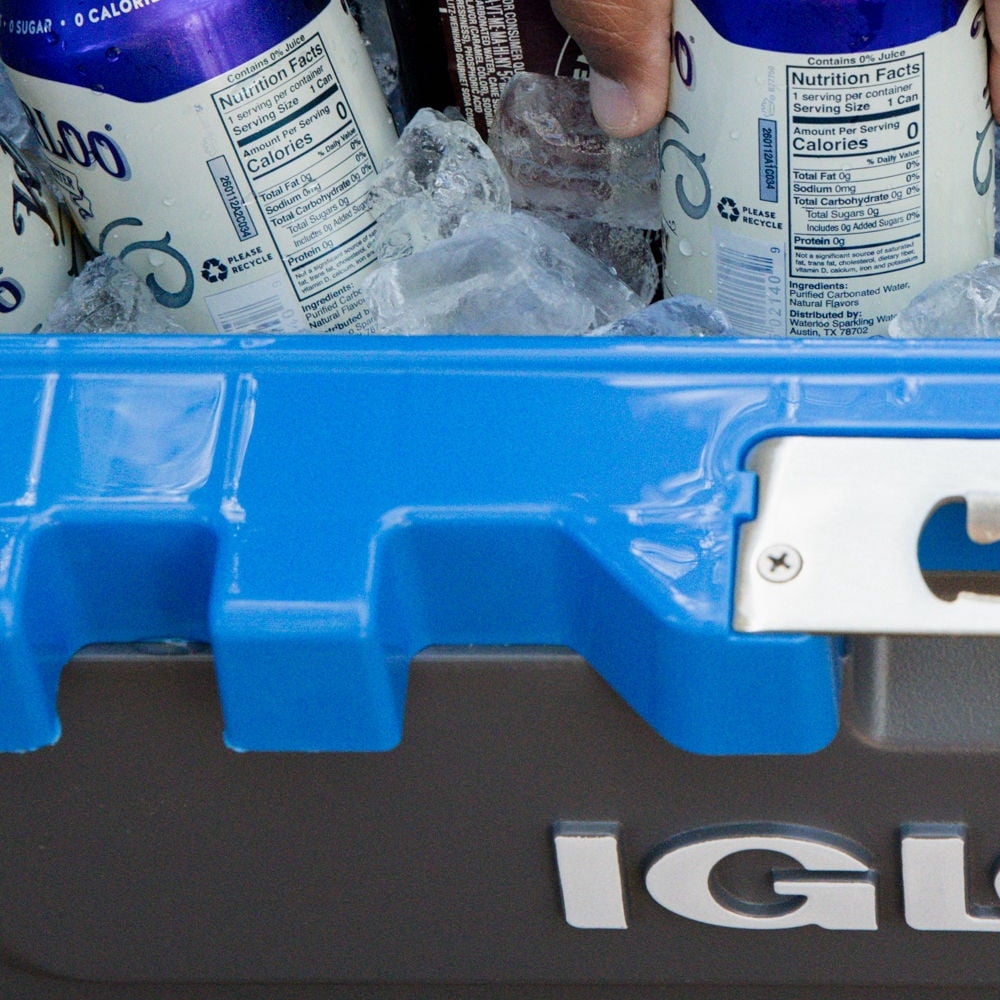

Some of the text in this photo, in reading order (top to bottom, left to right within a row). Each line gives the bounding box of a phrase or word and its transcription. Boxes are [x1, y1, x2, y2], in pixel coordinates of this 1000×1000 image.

[16, 19, 53, 35] SUGAR
[74, 12, 84, 27] 0
[468, 25, 484, 65] (CARAMEL
[504, 12, 524, 61] CONSUMER
[227, 34, 306, 83] Contains Juice
[483, 46, 496, 76] WATER,
[807, 50, 906, 66] Contains 0% Juice
[218, 43, 323, 110] Nutrition Facts
[455, 53, 469, 87] GOURMET
[464, 45, 481, 94] PHOSPHORIC
[792, 63, 920, 87] Nutrition Facts
[237, 64, 325, 122] serving per container
[461, 87, 472, 107] SODA
[488, 76, 500, 97] CANE
[802, 82, 913, 103] serving per container
[232, 73, 333, 136] Serving Size Can
[471, 94, 482, 113] ACID
[793, 93, 919, 115] Serving Size Can
[243, 105, 331, 158] Amount Per Serving
[247, 100, 348, 173] Calories 0
[792, 121, 919, 151] Calories 0
[793, 121, 900, 136] Amount Per Serving
[762, 127, 775, 190] 260112A1C034
[877, 149, 920, 165] Daily Value
[793, 160, 921, 182] Total Fat 0g 0%
[260, 178, 300, 203] Total Fat
[793, 173, 921, 195] Sodium 0mg 0%
[220, 175, 252, 238] 260112A2C034
[265, 193, 302, 215] Sodium
[270, 180, 351, 228] Total Carbohydrate
[793, 186, 921, 207] Total Carbohydrate 0%
[310, 204, 338, 225] Sugars
[743, 206, 776, 219] PLEASE
[743, 216, 783, 230] RECYCLE
[806, 207, 880, 220] Total Sugars 0g
[807, 211, 921, 232] Includes Added Sugars 0%
[794, 236, 846, 247] Protein 0g
[227, 247, 263, 265] PLEASE
[231, 253, 274, 275] RECYCLE
[287, 246, 322, 267] Protein
[815, 252, 850, 260] significant
[878, 253, 900, 263] dietary
[789, 281, 848, 291] Ingredients:
[789, 281, 911, 300] Purified Carbonated Water,
[301, 282, 355, 313] Ingredients:
[789, 299, 860, 309] Natural Flavors
[305, 302, 338, 322] Purified
[309, 309, 342, 330] Natural
[789, 309, 863, 321] Distributed by:
[789, 317, 874, 329] Waterloo Sparkling
[789, 326, 869, 337] Austin, TX 78702
